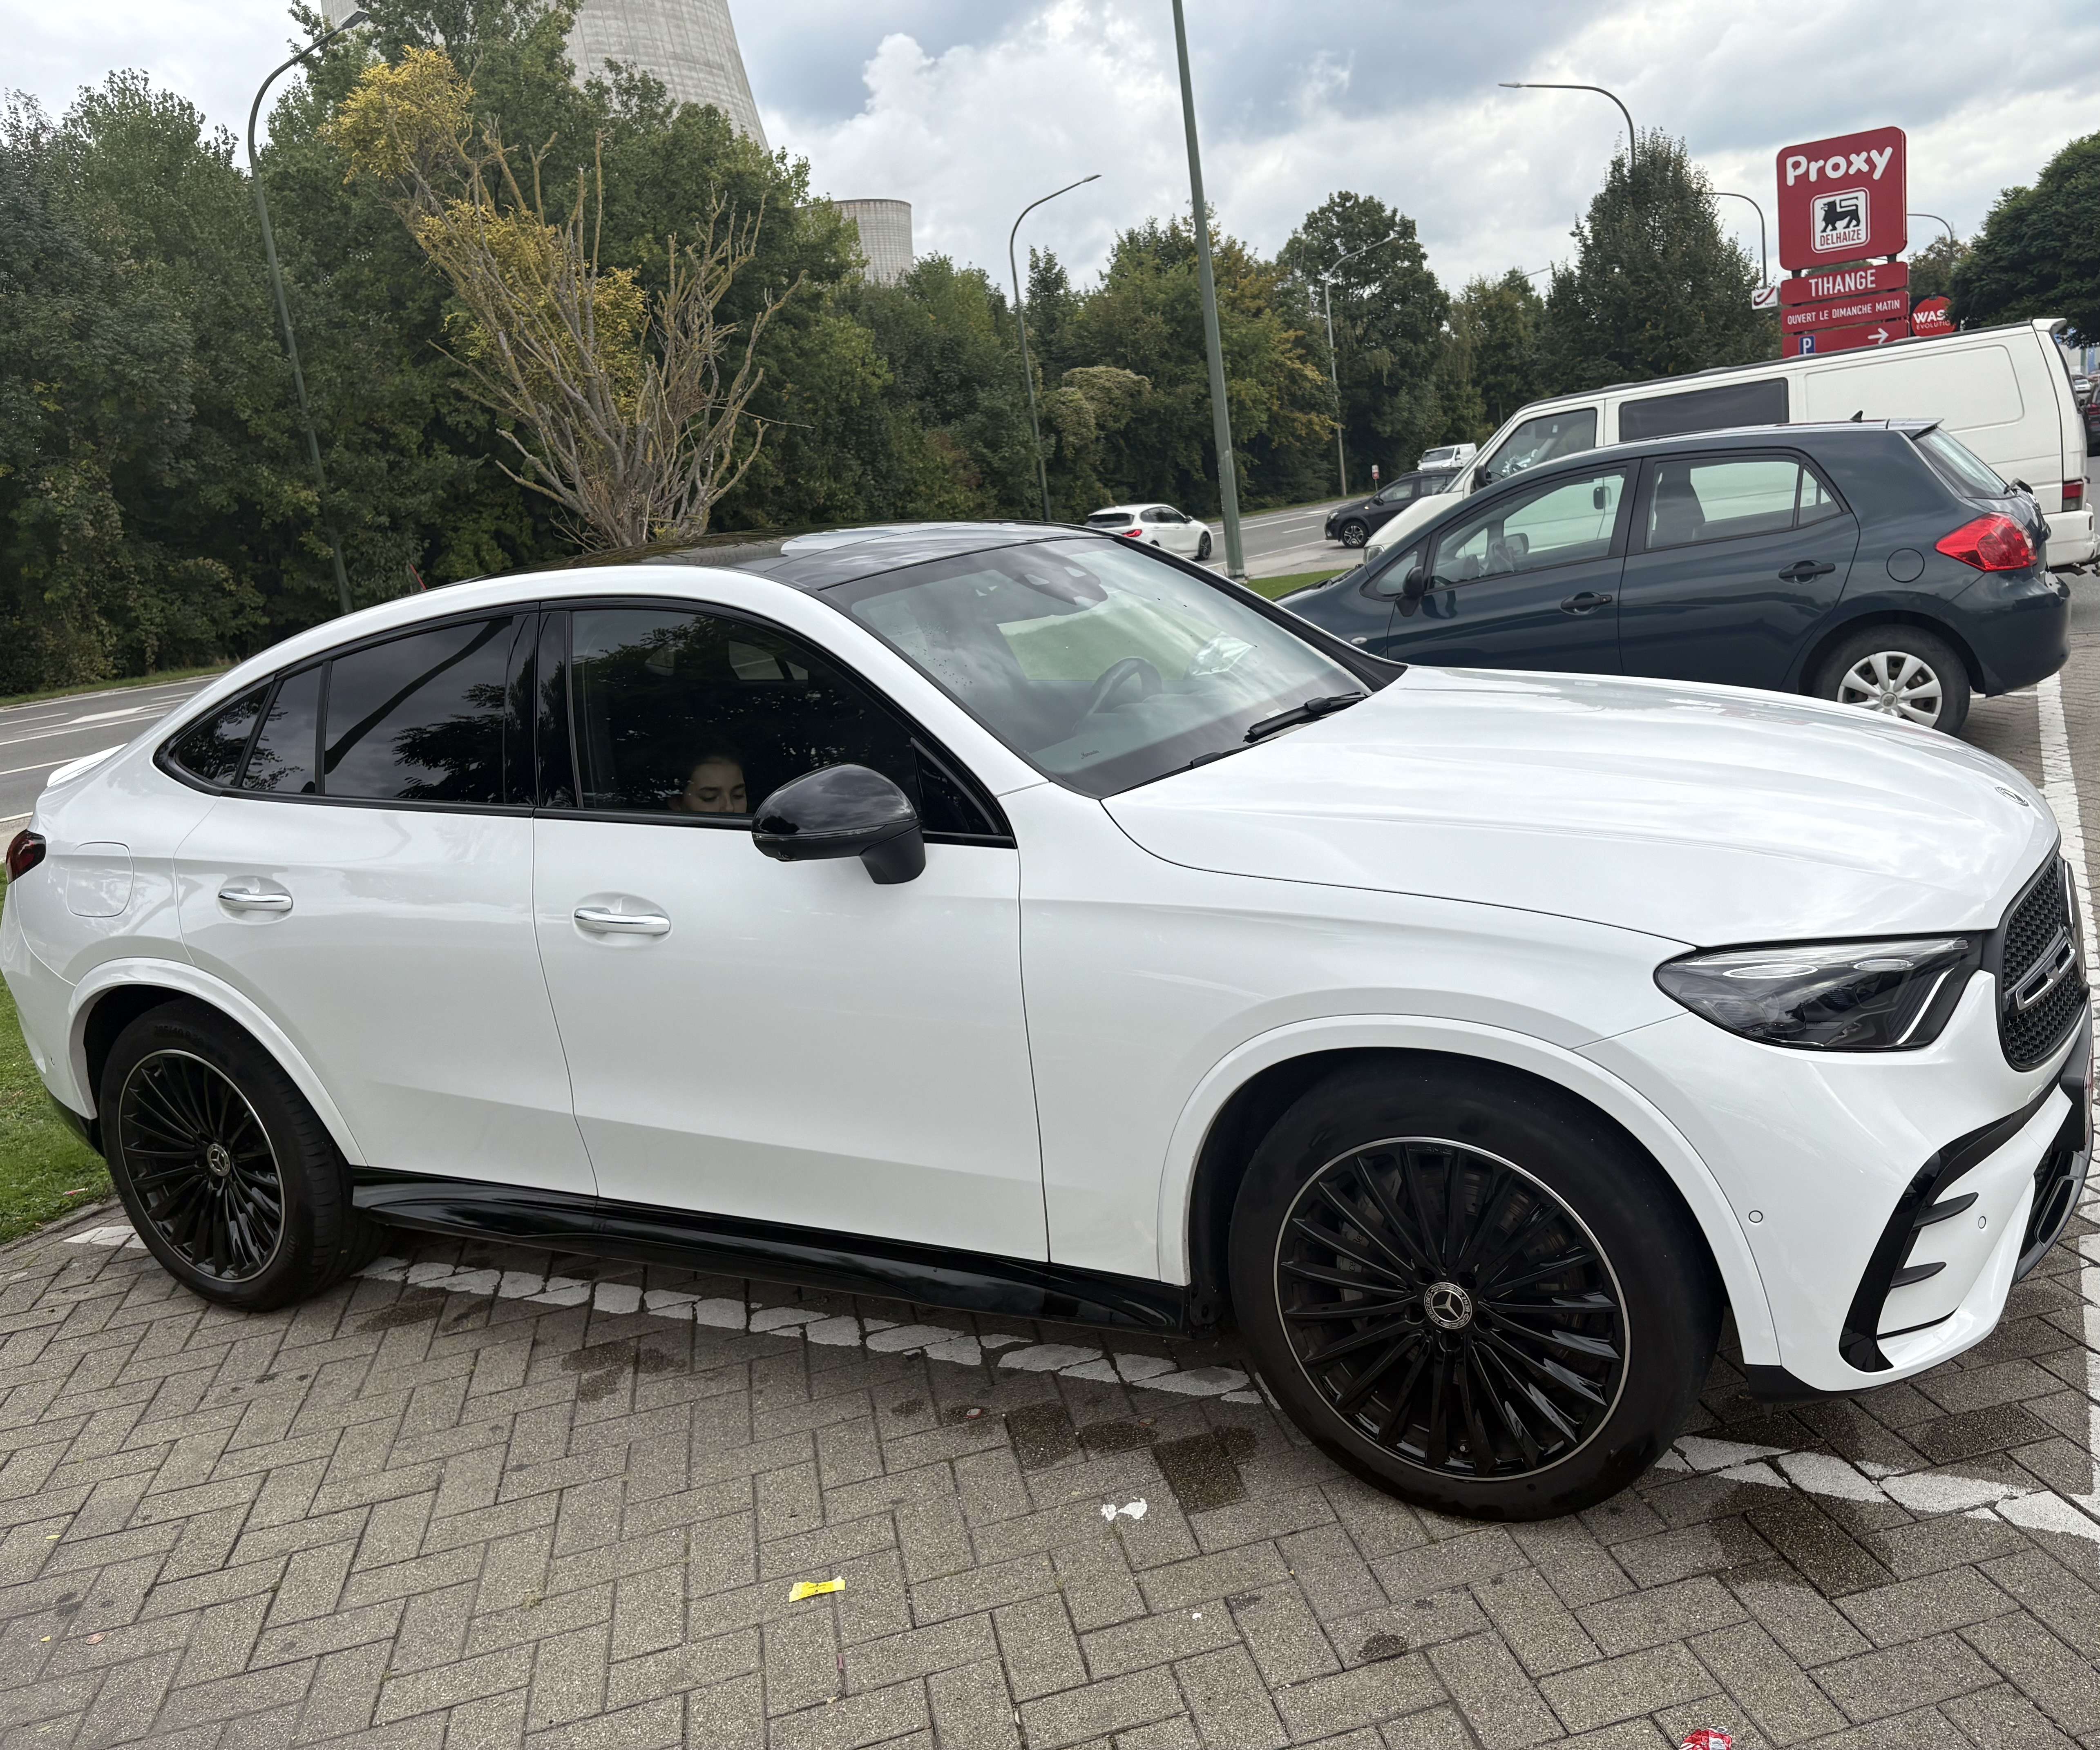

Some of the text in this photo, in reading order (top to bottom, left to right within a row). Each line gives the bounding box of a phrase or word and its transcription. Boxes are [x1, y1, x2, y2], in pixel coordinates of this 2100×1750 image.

[1786, 146, 1893, 186] Proxy
[1820, 229, 1862, 247] DELHAIZE
[1809, 269, 1876, 297] TIHANGE
[1787, 299, 1900, 325] OUVERT LE DIMANCHE MATIN
[1912, 309, 1946, 324] WAS
[1916, 320, 1950, 330] EVOLUTIO
[1803, 337, 1812, 355] P
[1425, 1292, 1439, 1322] MERCEDES
[1461, 1296, 1470, 1312] BENZ
